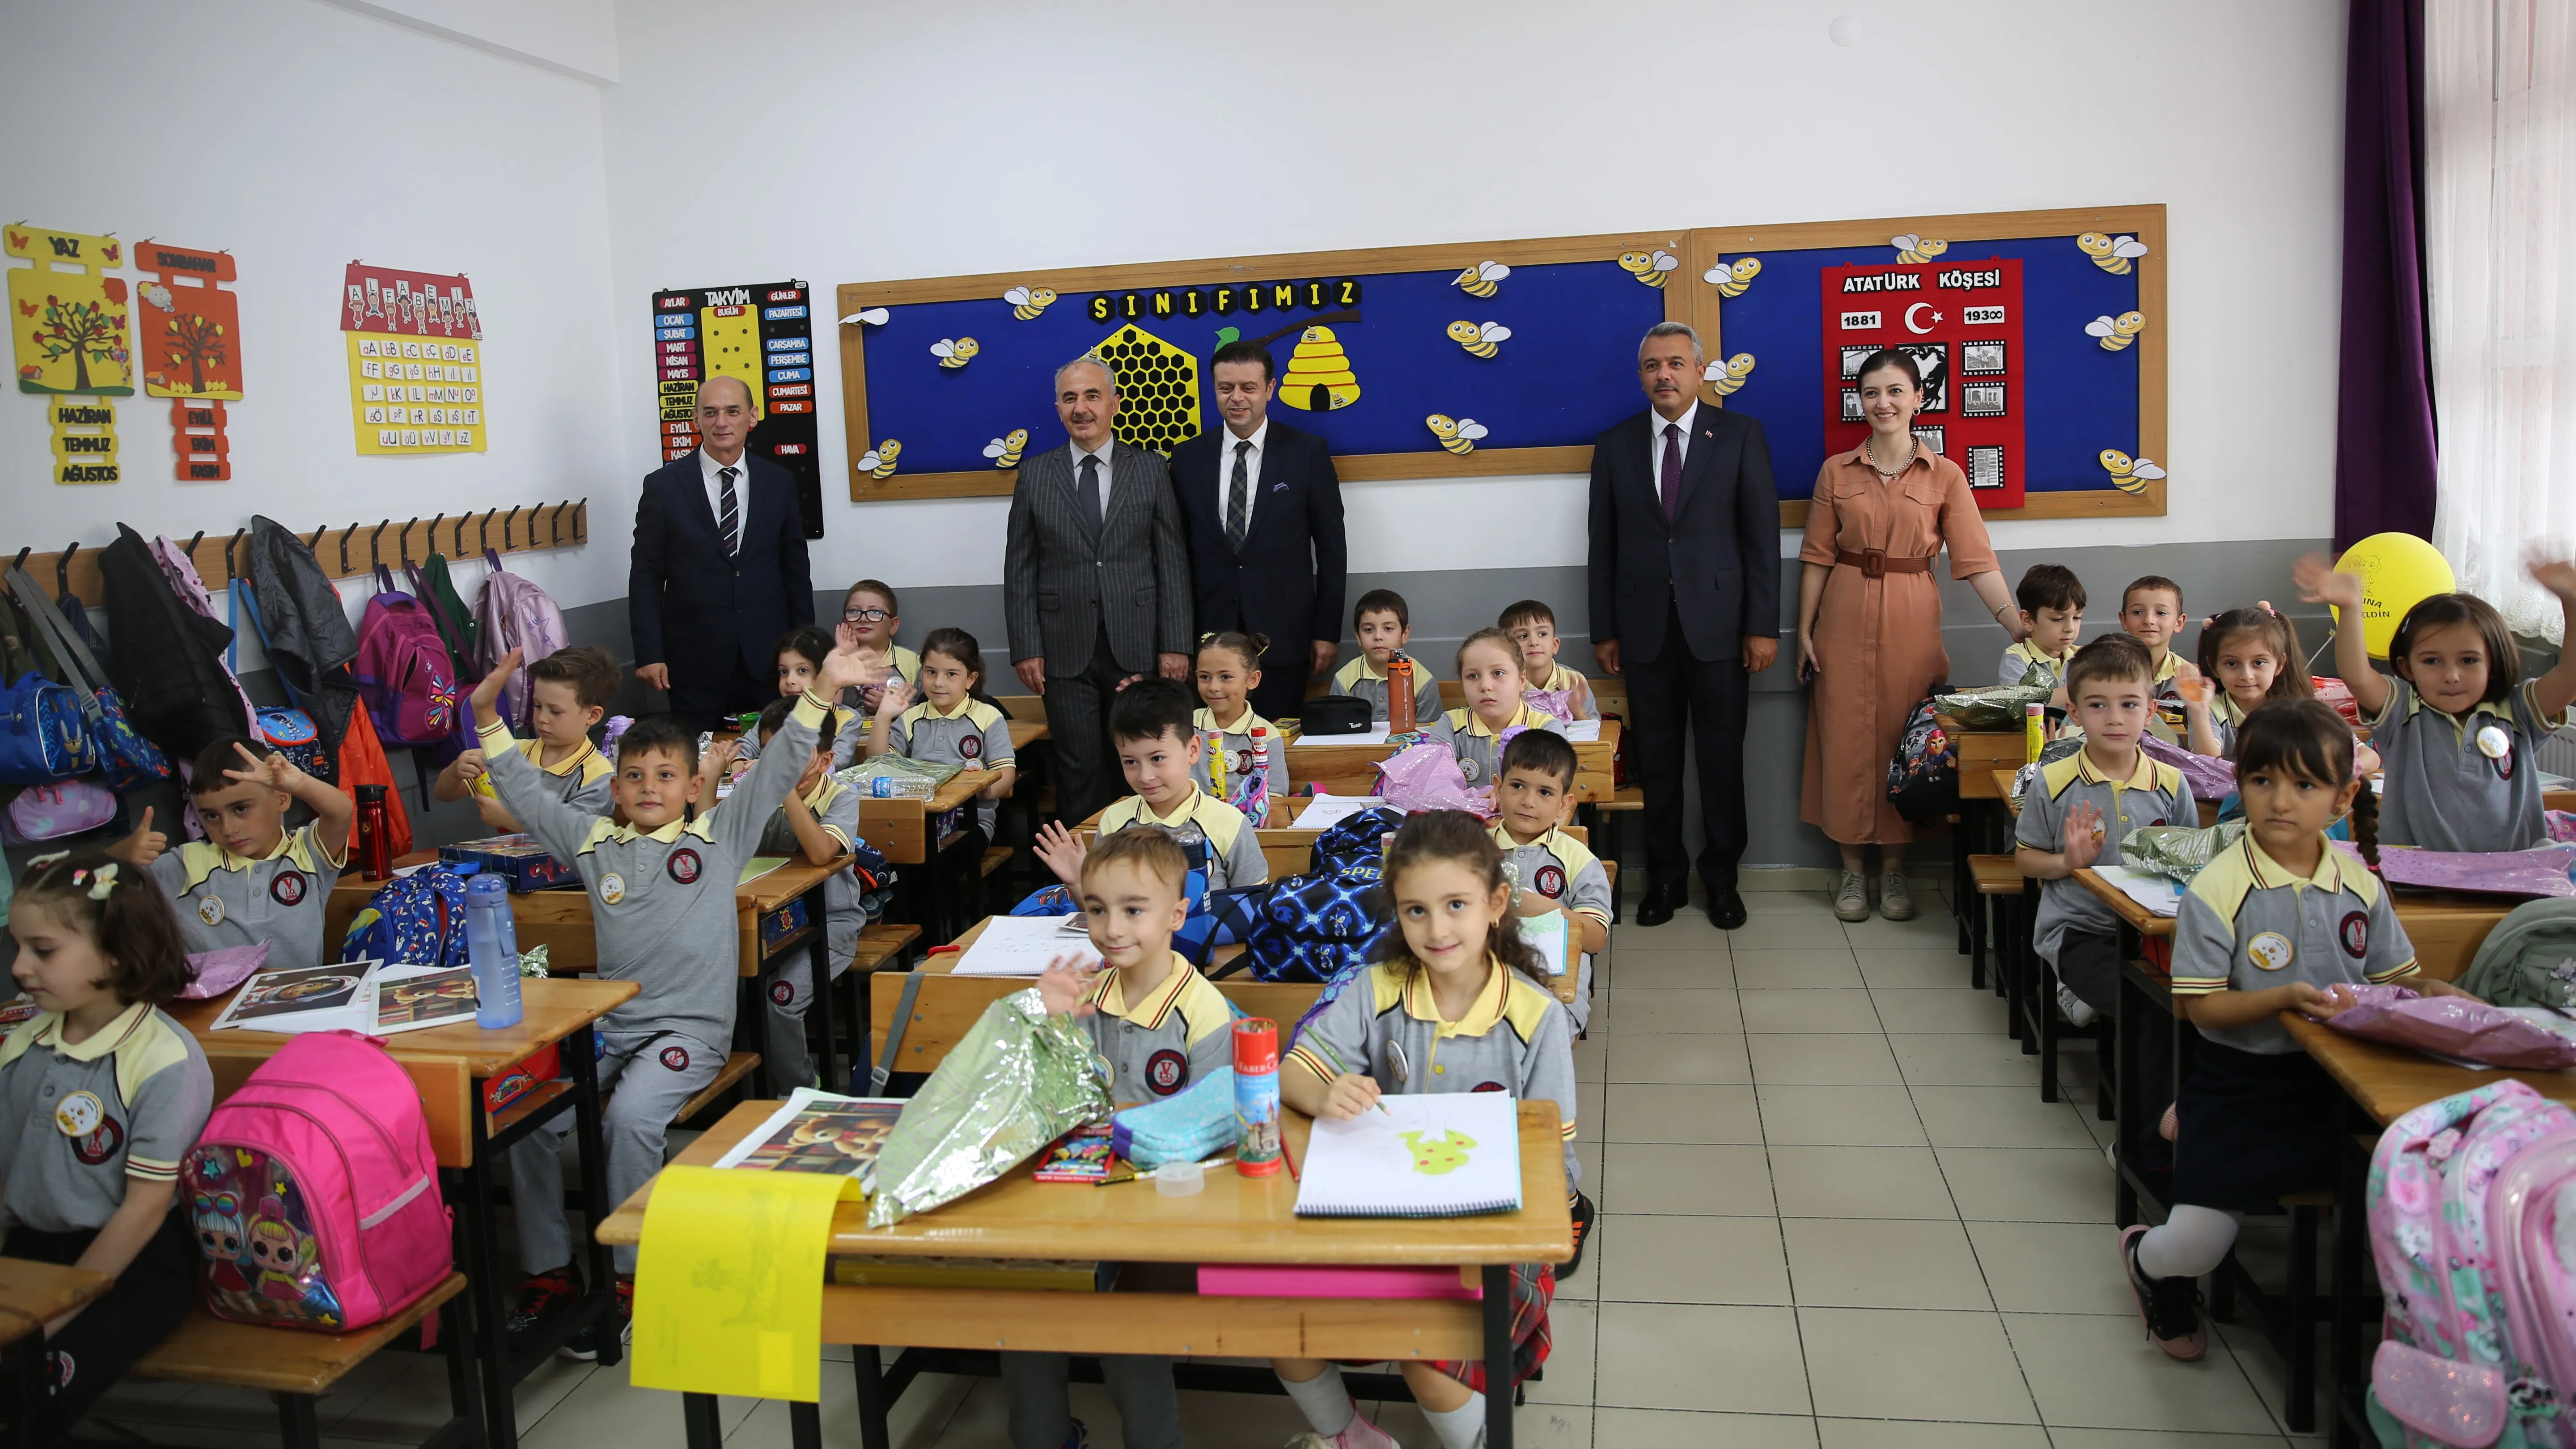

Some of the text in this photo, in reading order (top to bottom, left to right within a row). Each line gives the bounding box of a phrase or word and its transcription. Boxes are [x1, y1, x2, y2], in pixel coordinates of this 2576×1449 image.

[48, 236, 80, 258] YAZ
[1843, 268, 2000, 293] ATATÜRK KÖŞESİ
[705, 288, 750, 306] TAKVİM
[771, 290, 796, 301] GÜNLER
[664, 297, 685, 307] AYLAR
[717, 306, 739, 316] BUGÜN
[768, 306, 803, 318] PAZARTESİ
[663, 315, 684, 326] OCAK
[1844, 314, 1876, 326] 1881
[664, 329, 686, 339] ŞUBAT
[666, 343, 686, 352] MART
[769, 339, 805, 350] ÇARŞAMBA
[666, 355, 688, 365] NİSAN
[770, 354, 806, 365] PERŞEMBE
[667, 369, 689, 379] MAYIS
[777, 371, 800, 380] CUMA
[663, 381, 695, 393] HAZİRAN
[772, 385, 808, 396] CUMARTESİ
[665, 397, 693, 406] TEMMUZ
[663, 407, 692, 419] AĞUSTO
[780, 403, 802, 412] PAZAR
[59, 406, 111, 425] HAZİRAN
[670, 421, 692, 433] EYLÜL
[63, 436, 110, 453] TEMMUZ
[672, 436, 692, 447] EKİM
[780, 445, 800, 454] HAVA
[62, 465, 118, 482] AĞUSTOS
[1546, 872, 1557, 883] V
[282, 878, 293, 889] V
[2353, 921, 2365, 936] V
[1160, 1062, 1173, 1074] V
